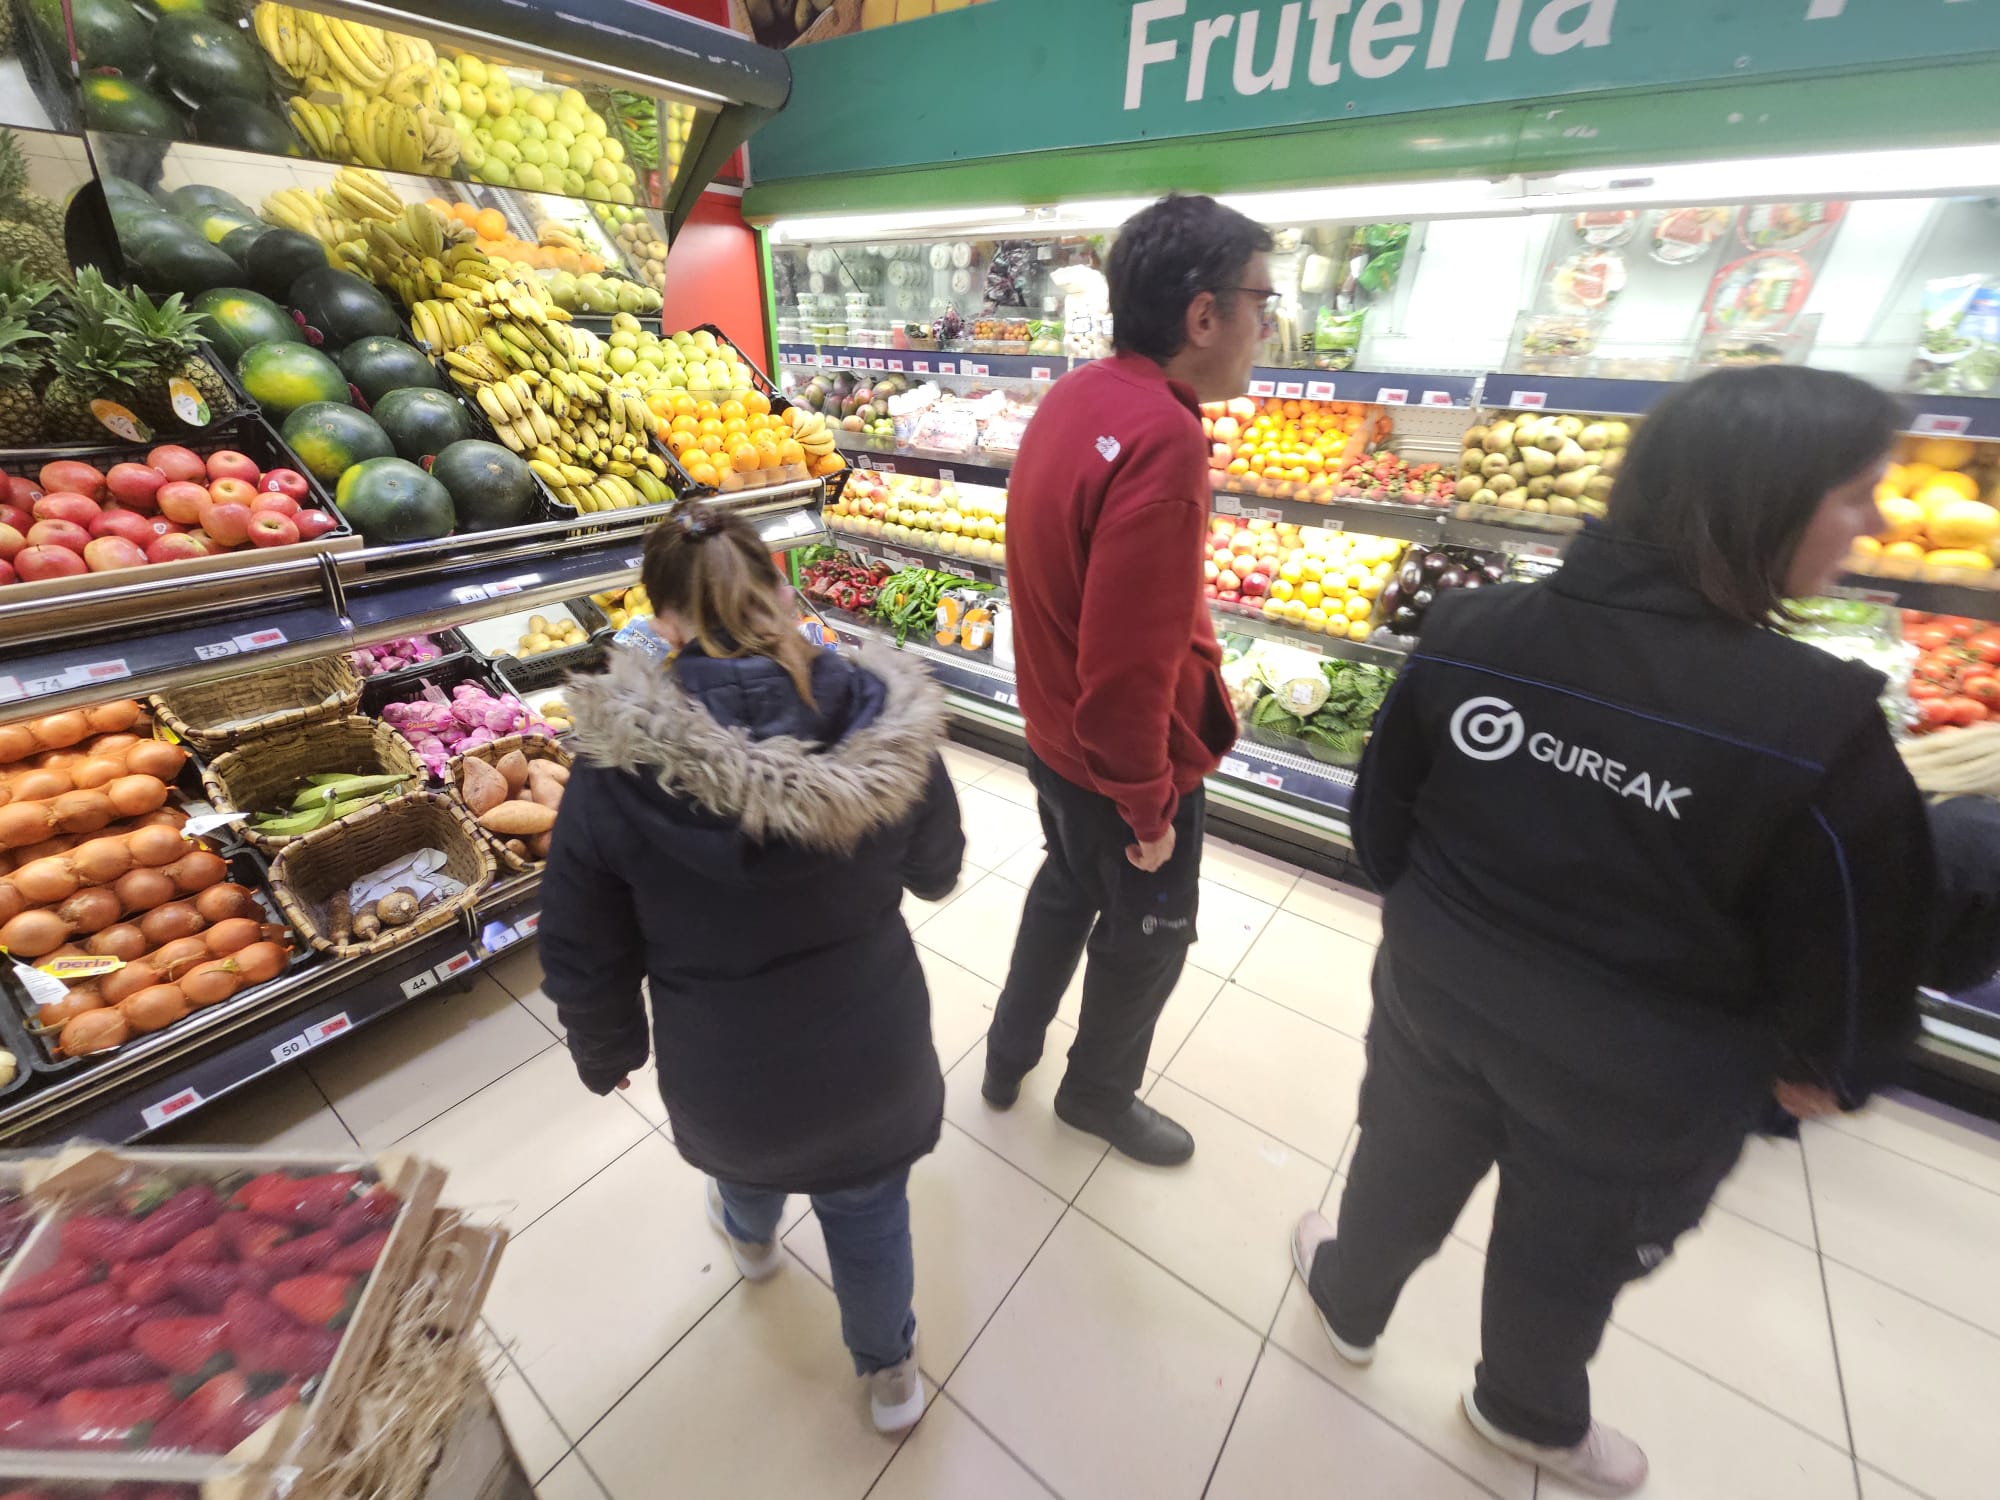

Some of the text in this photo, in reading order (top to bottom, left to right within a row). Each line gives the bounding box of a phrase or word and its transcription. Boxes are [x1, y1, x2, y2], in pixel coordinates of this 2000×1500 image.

[200, 644, 229, 657] 73
[36, 678, 63, 692] 74
[1528, 731, 1693, 820] GUREAK
[412, 977, 427, 990] 44
[282, 1042, 300, 1056] 50
